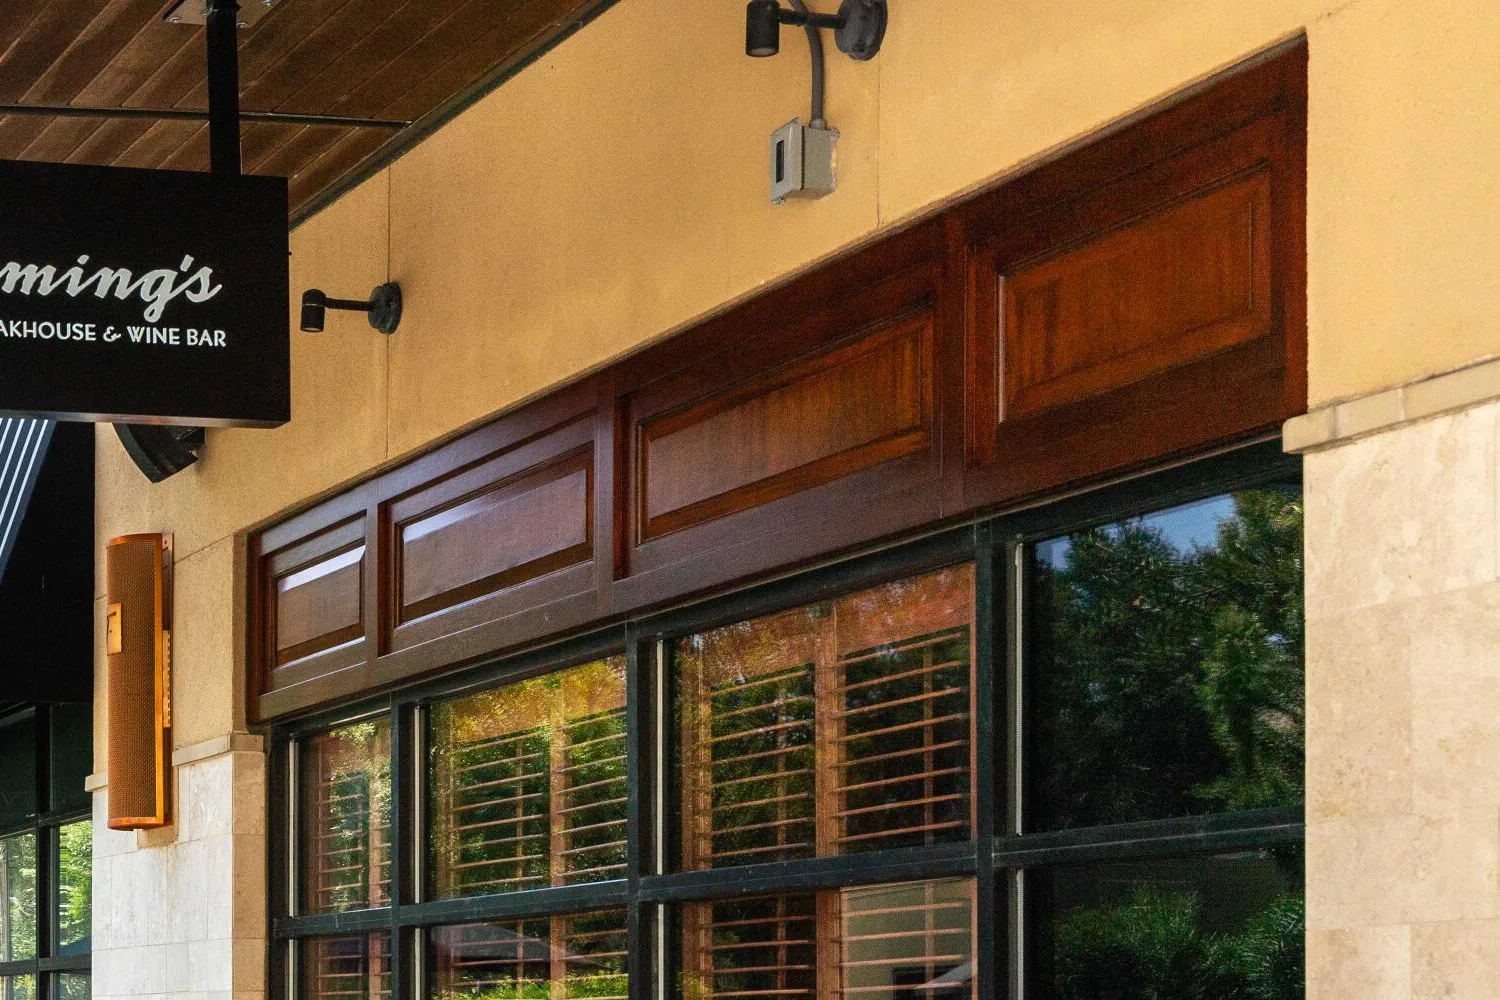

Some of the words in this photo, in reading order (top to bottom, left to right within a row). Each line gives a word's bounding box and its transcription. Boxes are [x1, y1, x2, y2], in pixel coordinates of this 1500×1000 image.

[103, 325, 121, 342] &
[127, 326, 180, 345] WINE
[187, 329, 226, 347] BAR
